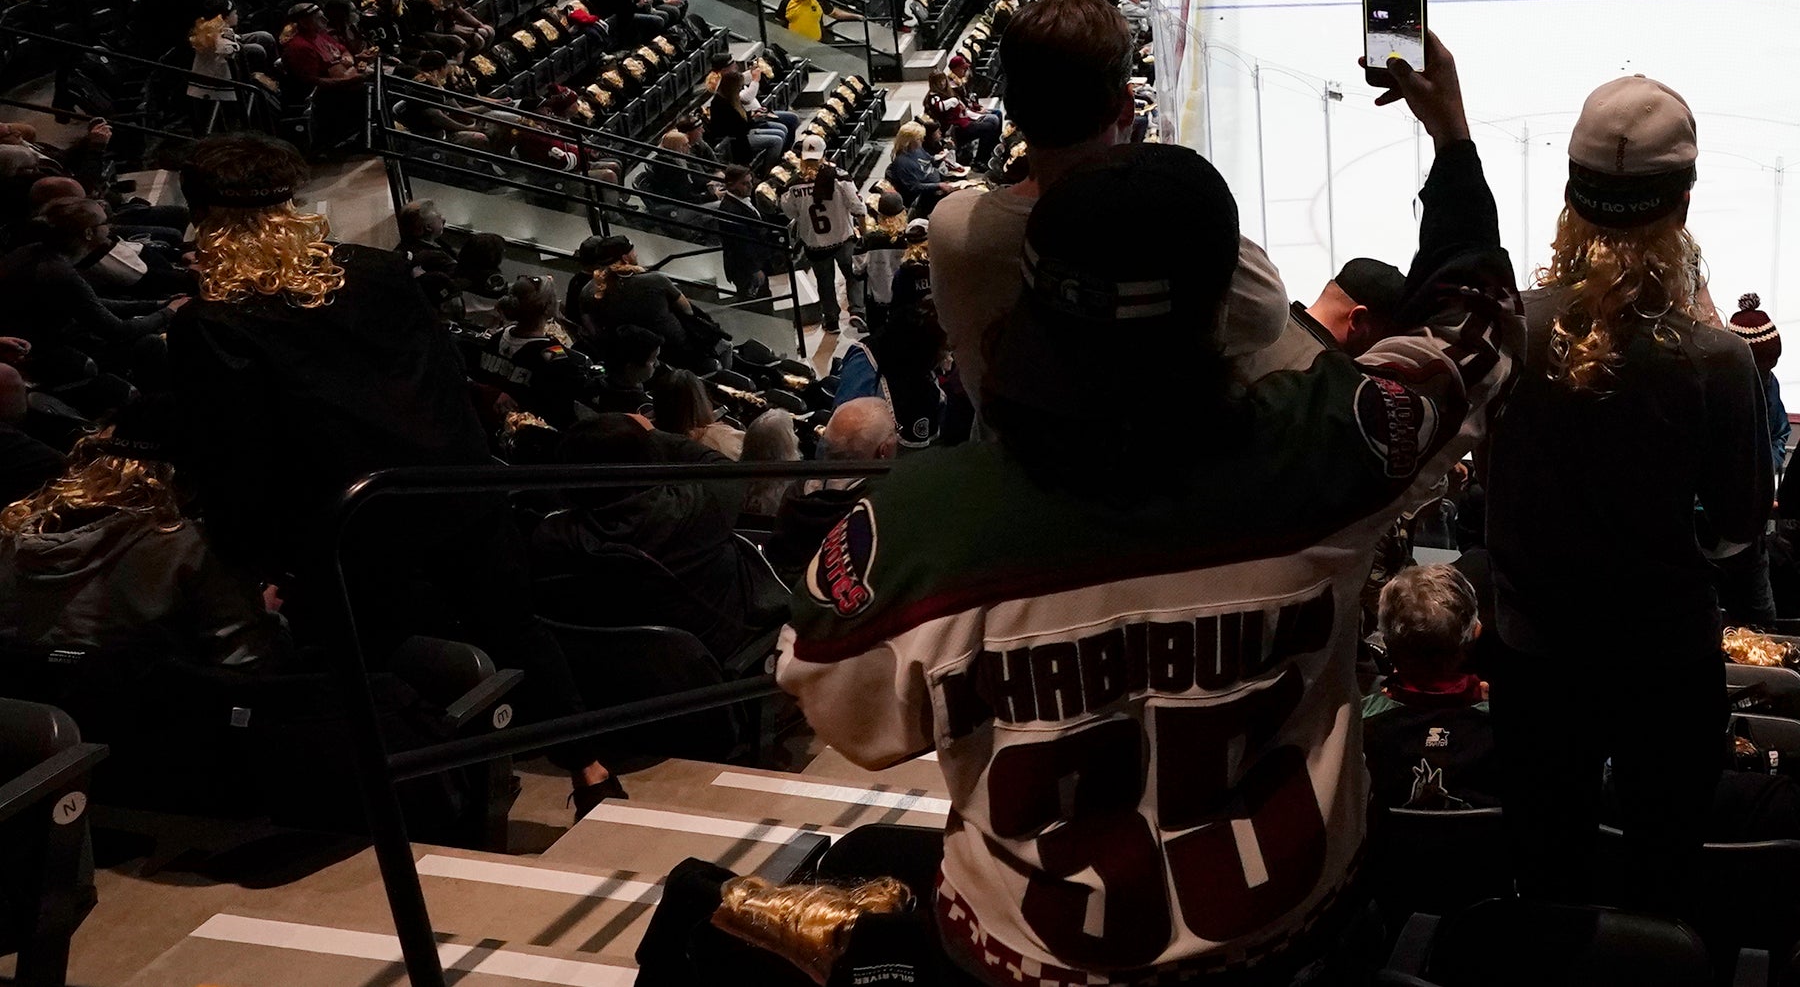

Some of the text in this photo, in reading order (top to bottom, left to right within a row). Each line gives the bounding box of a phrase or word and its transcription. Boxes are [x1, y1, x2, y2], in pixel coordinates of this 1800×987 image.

[1573, 188, 1661, 213] YOU DO YOU
[808, 204, 832, 234] 6
[988, 662, 1328, 968] 35
[852, 973, 890, 985] RIVER
[891, 972, 915, 983] GILA
